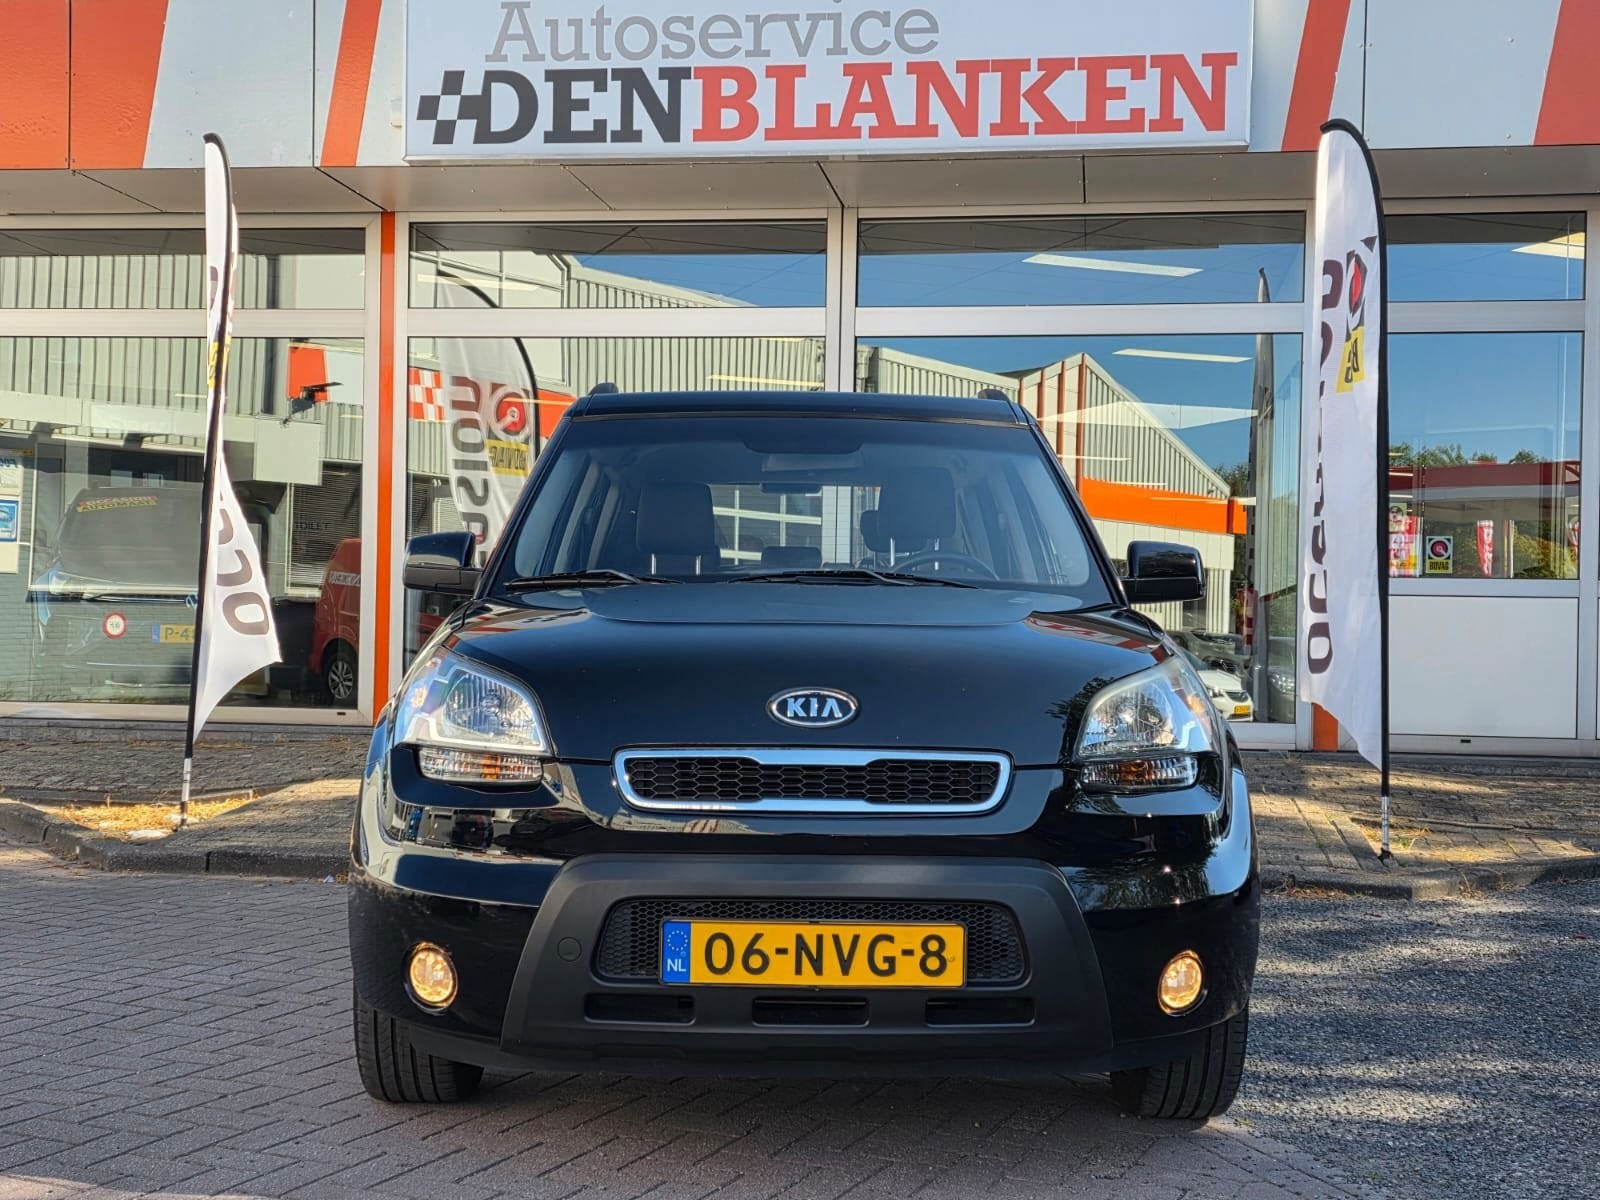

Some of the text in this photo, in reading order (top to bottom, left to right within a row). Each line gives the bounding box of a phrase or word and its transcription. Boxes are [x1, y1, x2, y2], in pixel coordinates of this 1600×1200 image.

[485, 0, 939, 62] Autoservice
[1429, 561, 1449, 571] BOVAG
[786, 697, 843, 718] KIA
[704, 931, 948, 978] 06-NVG-8
[667, 958, 687, 973] NL
